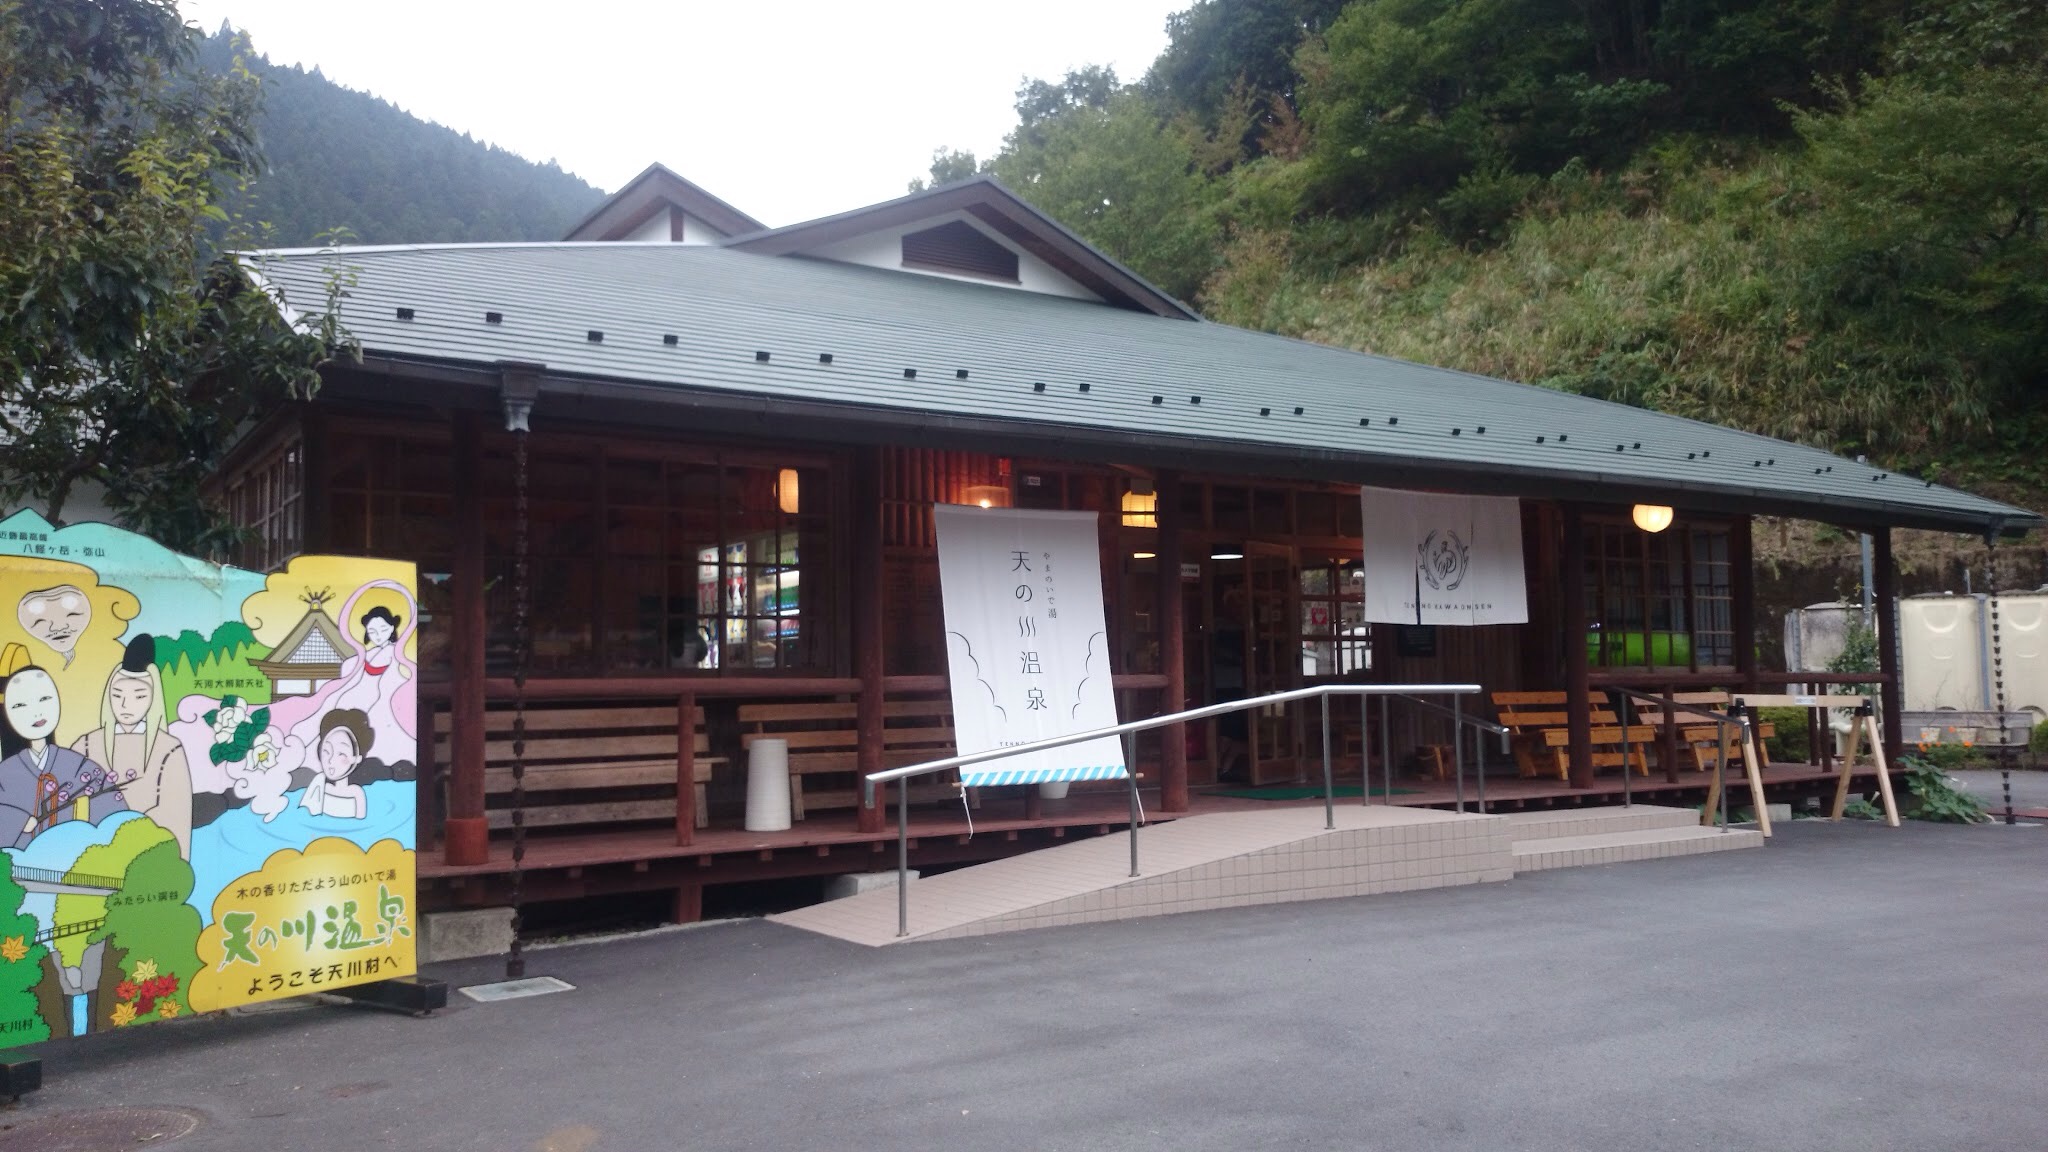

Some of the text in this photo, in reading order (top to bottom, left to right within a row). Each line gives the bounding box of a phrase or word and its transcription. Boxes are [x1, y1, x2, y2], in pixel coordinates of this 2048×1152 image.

[1043, 552, 1057, 619] やまのいで湯
[237, 868, 397, 900] 木の香りただよう山のいで湯
[217, 884, 411, 972] 天の川温泉
[248, 955, 398, 996] ようこそ天川村へ
